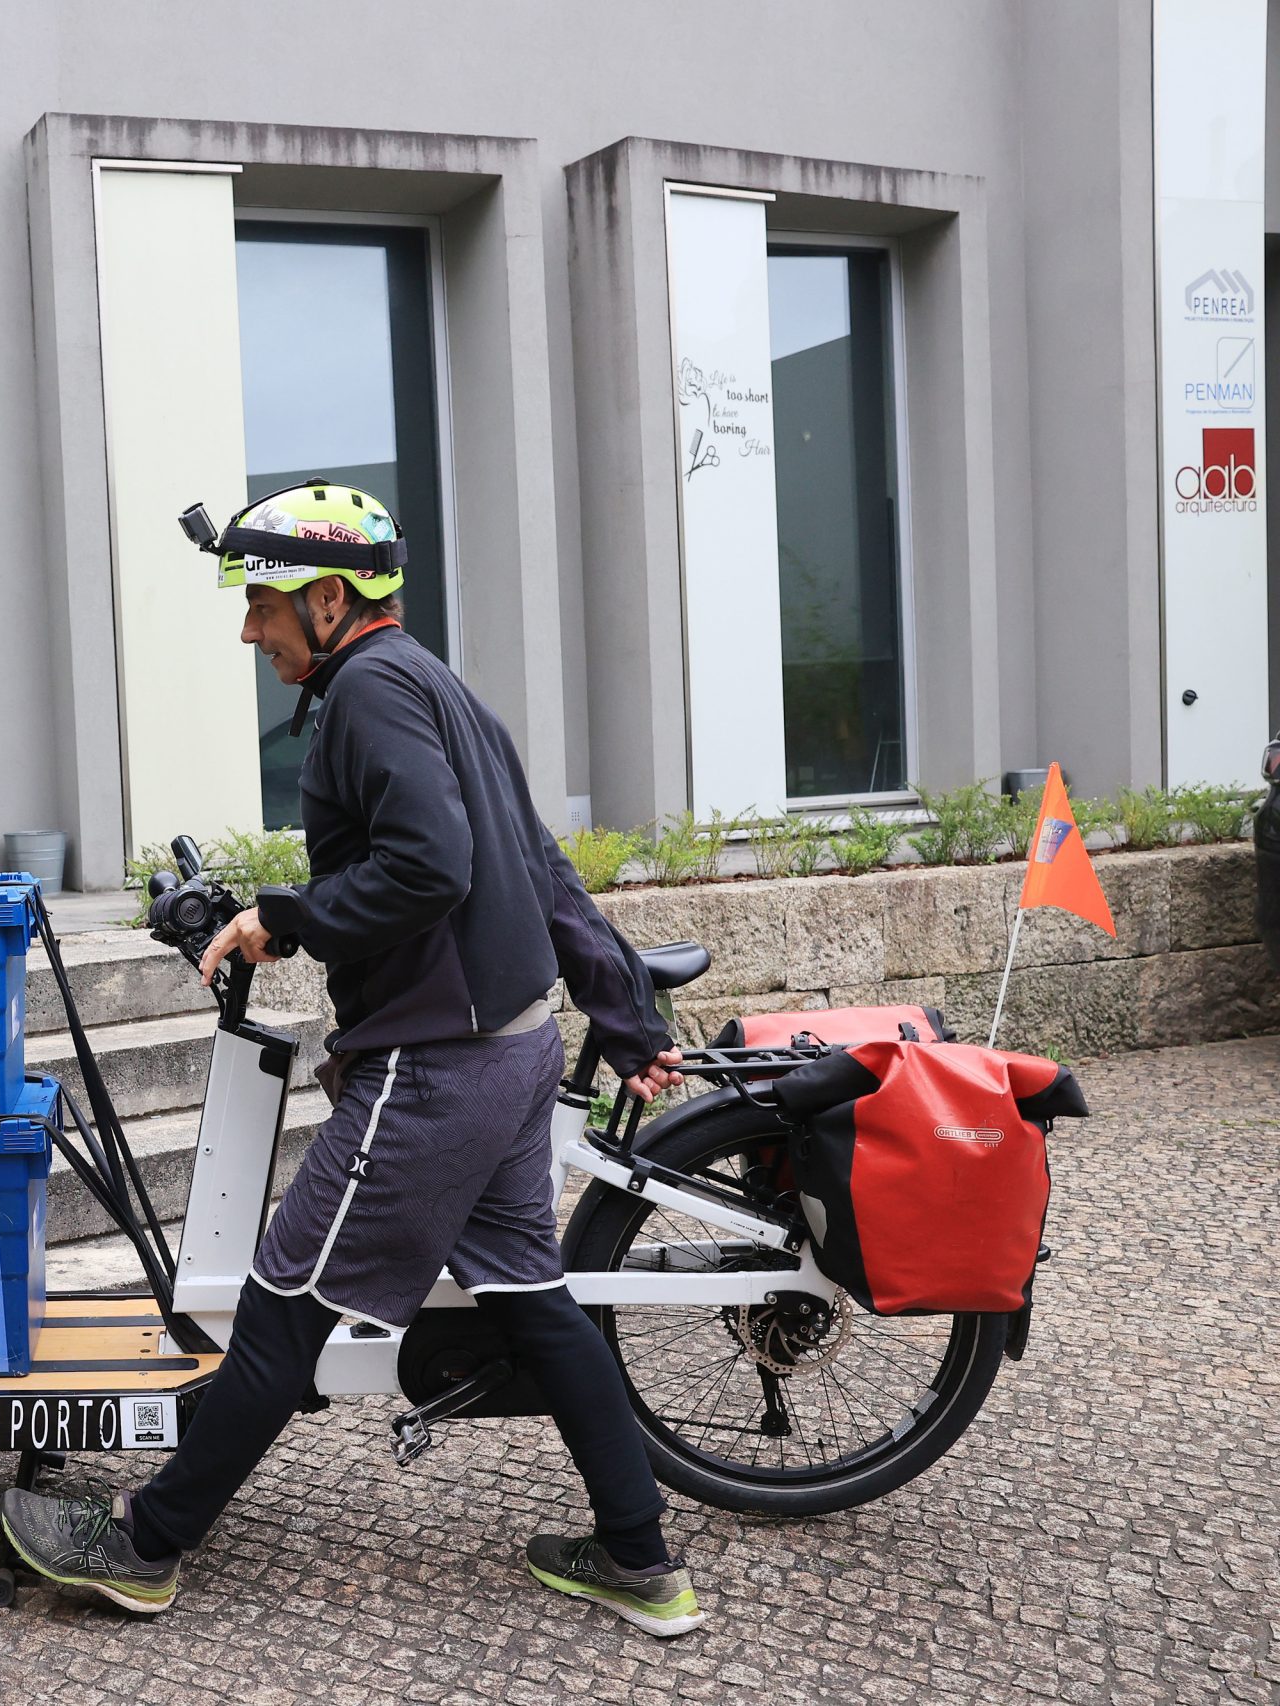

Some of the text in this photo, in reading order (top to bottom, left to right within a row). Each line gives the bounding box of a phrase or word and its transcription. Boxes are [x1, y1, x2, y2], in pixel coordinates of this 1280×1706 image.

[1193, 297, 1247, 315] PENREA
[727, 388, 769, 403] too short
[1185, 383, 1253, 401] PENMAN
[713, 420, 747, 438] boring
[738, 438, 771, 457] Hair
[1175, 499, 1257, 517] arquitectura
[328, 523, 360, 543] VANS
[185, 903, 200, 920] JBL
[938, 1129, 972, 1138] ORTLIEB
[11, 1399, 118, 1450] PORTO
